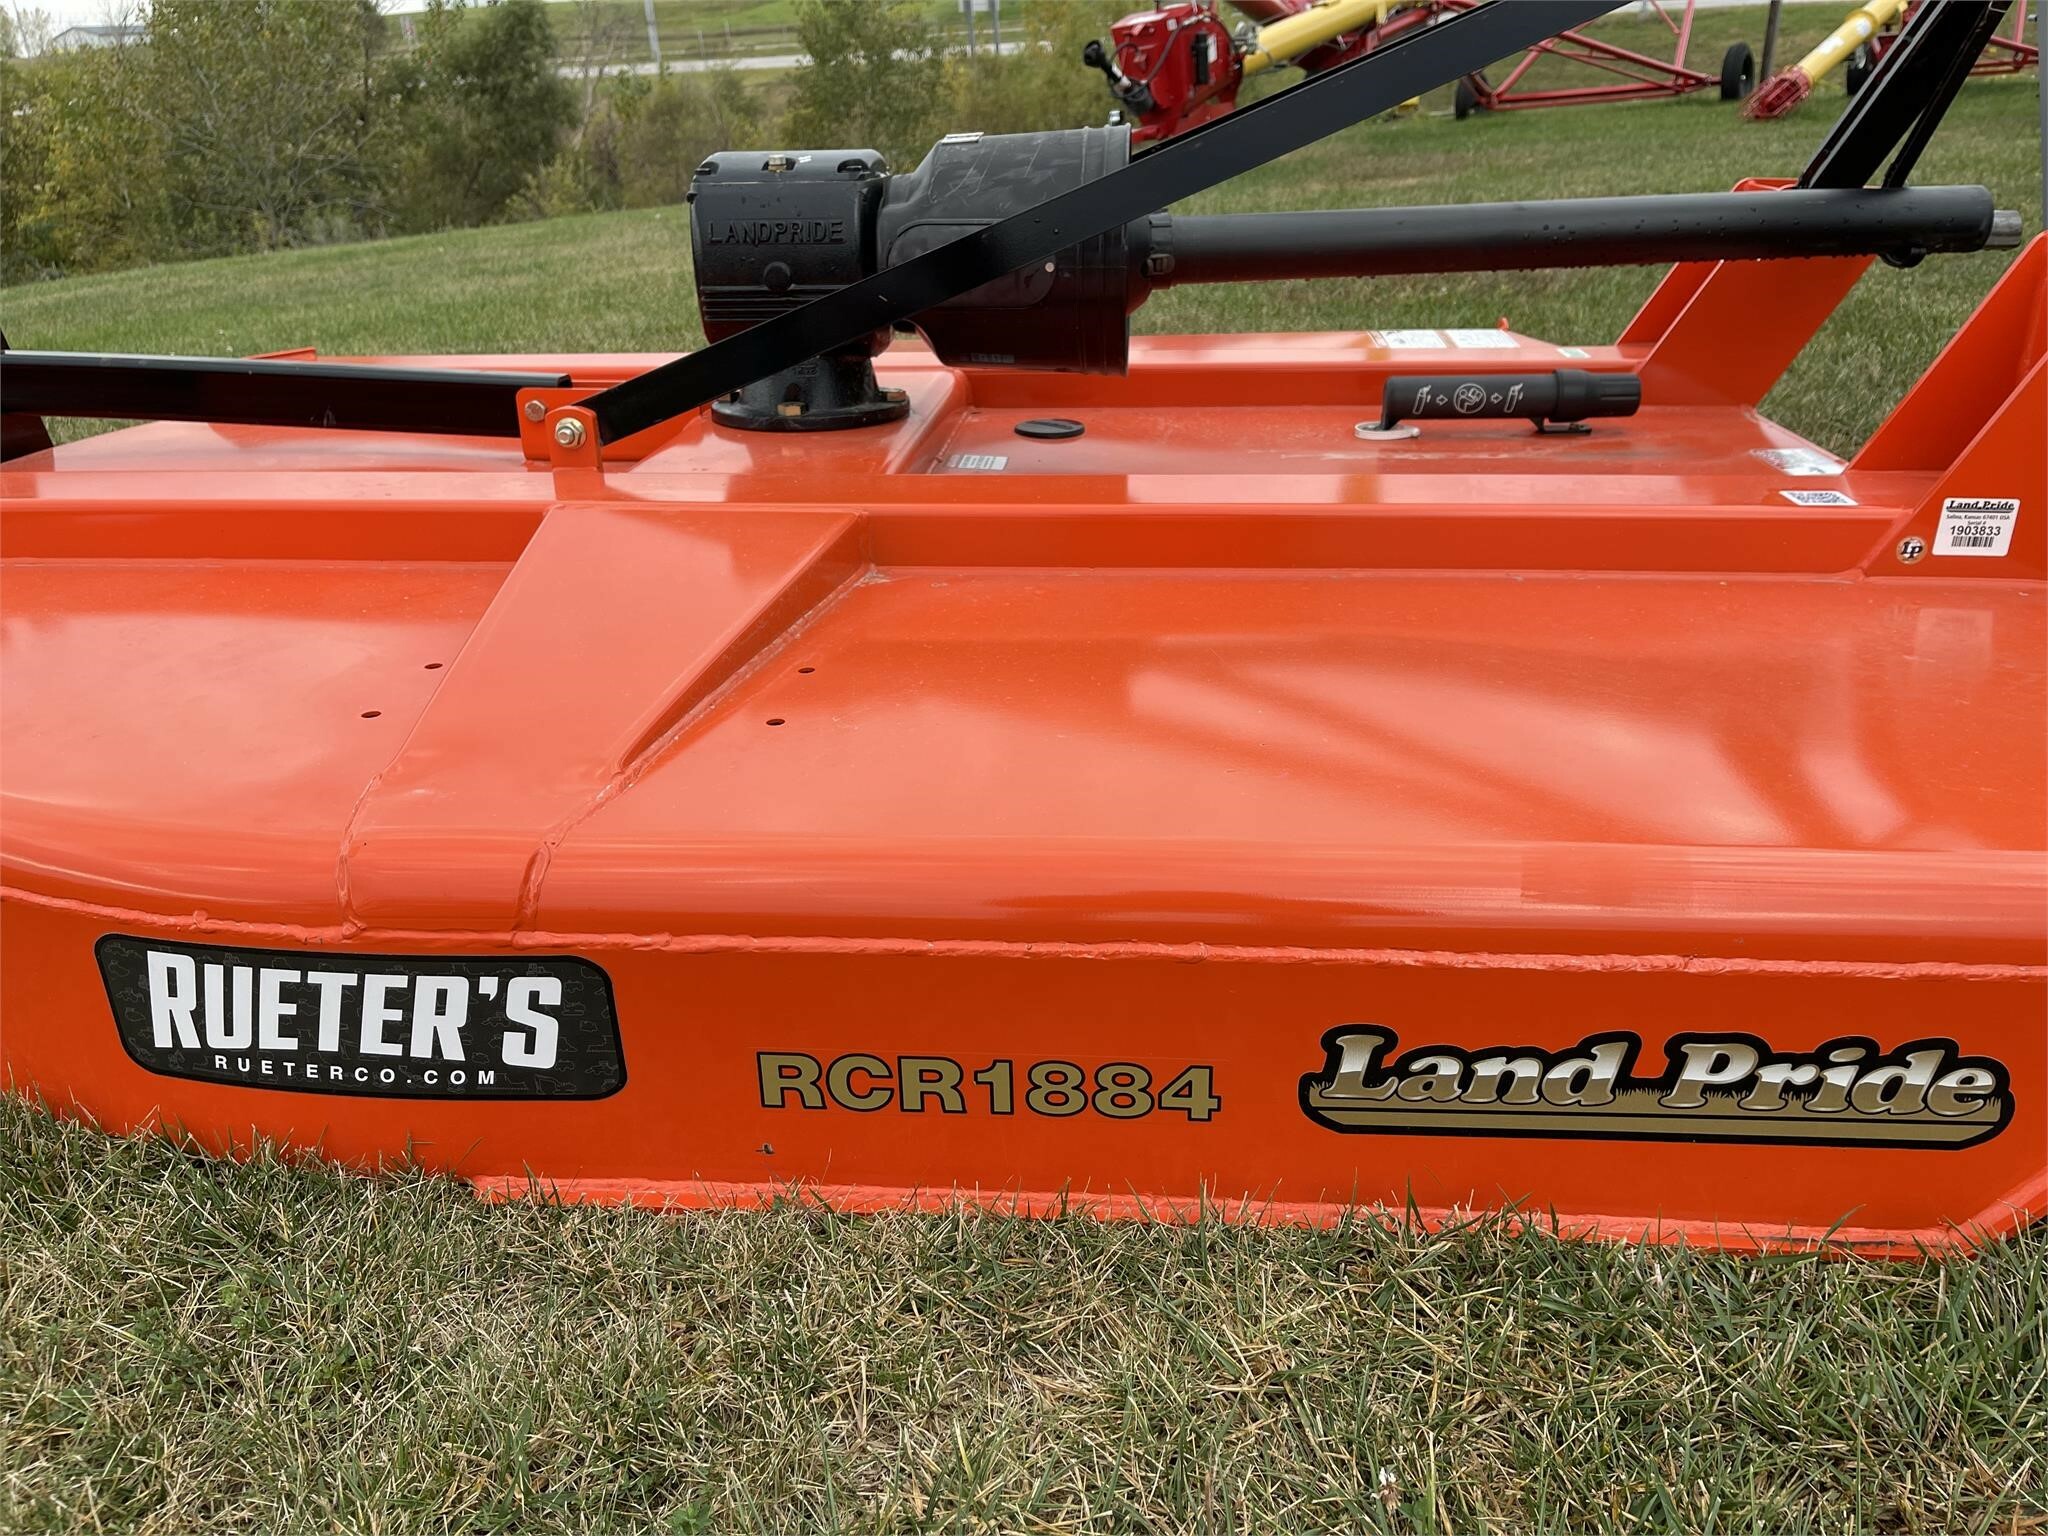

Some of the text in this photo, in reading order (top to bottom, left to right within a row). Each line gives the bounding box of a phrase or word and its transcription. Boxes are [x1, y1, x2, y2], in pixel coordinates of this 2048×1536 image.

[708, 221, 845, 245] LANDPRIDE
[1947, 500, 2015, 511] Land Pride
[1950, 526, 2001, 535] 1903833
[214, 1054, 496, 1085] RUETERCO.COM
[1320, 1033, 2001, 1118] Land Pride
[757, 1052, 1221, 1122] RCR1884
